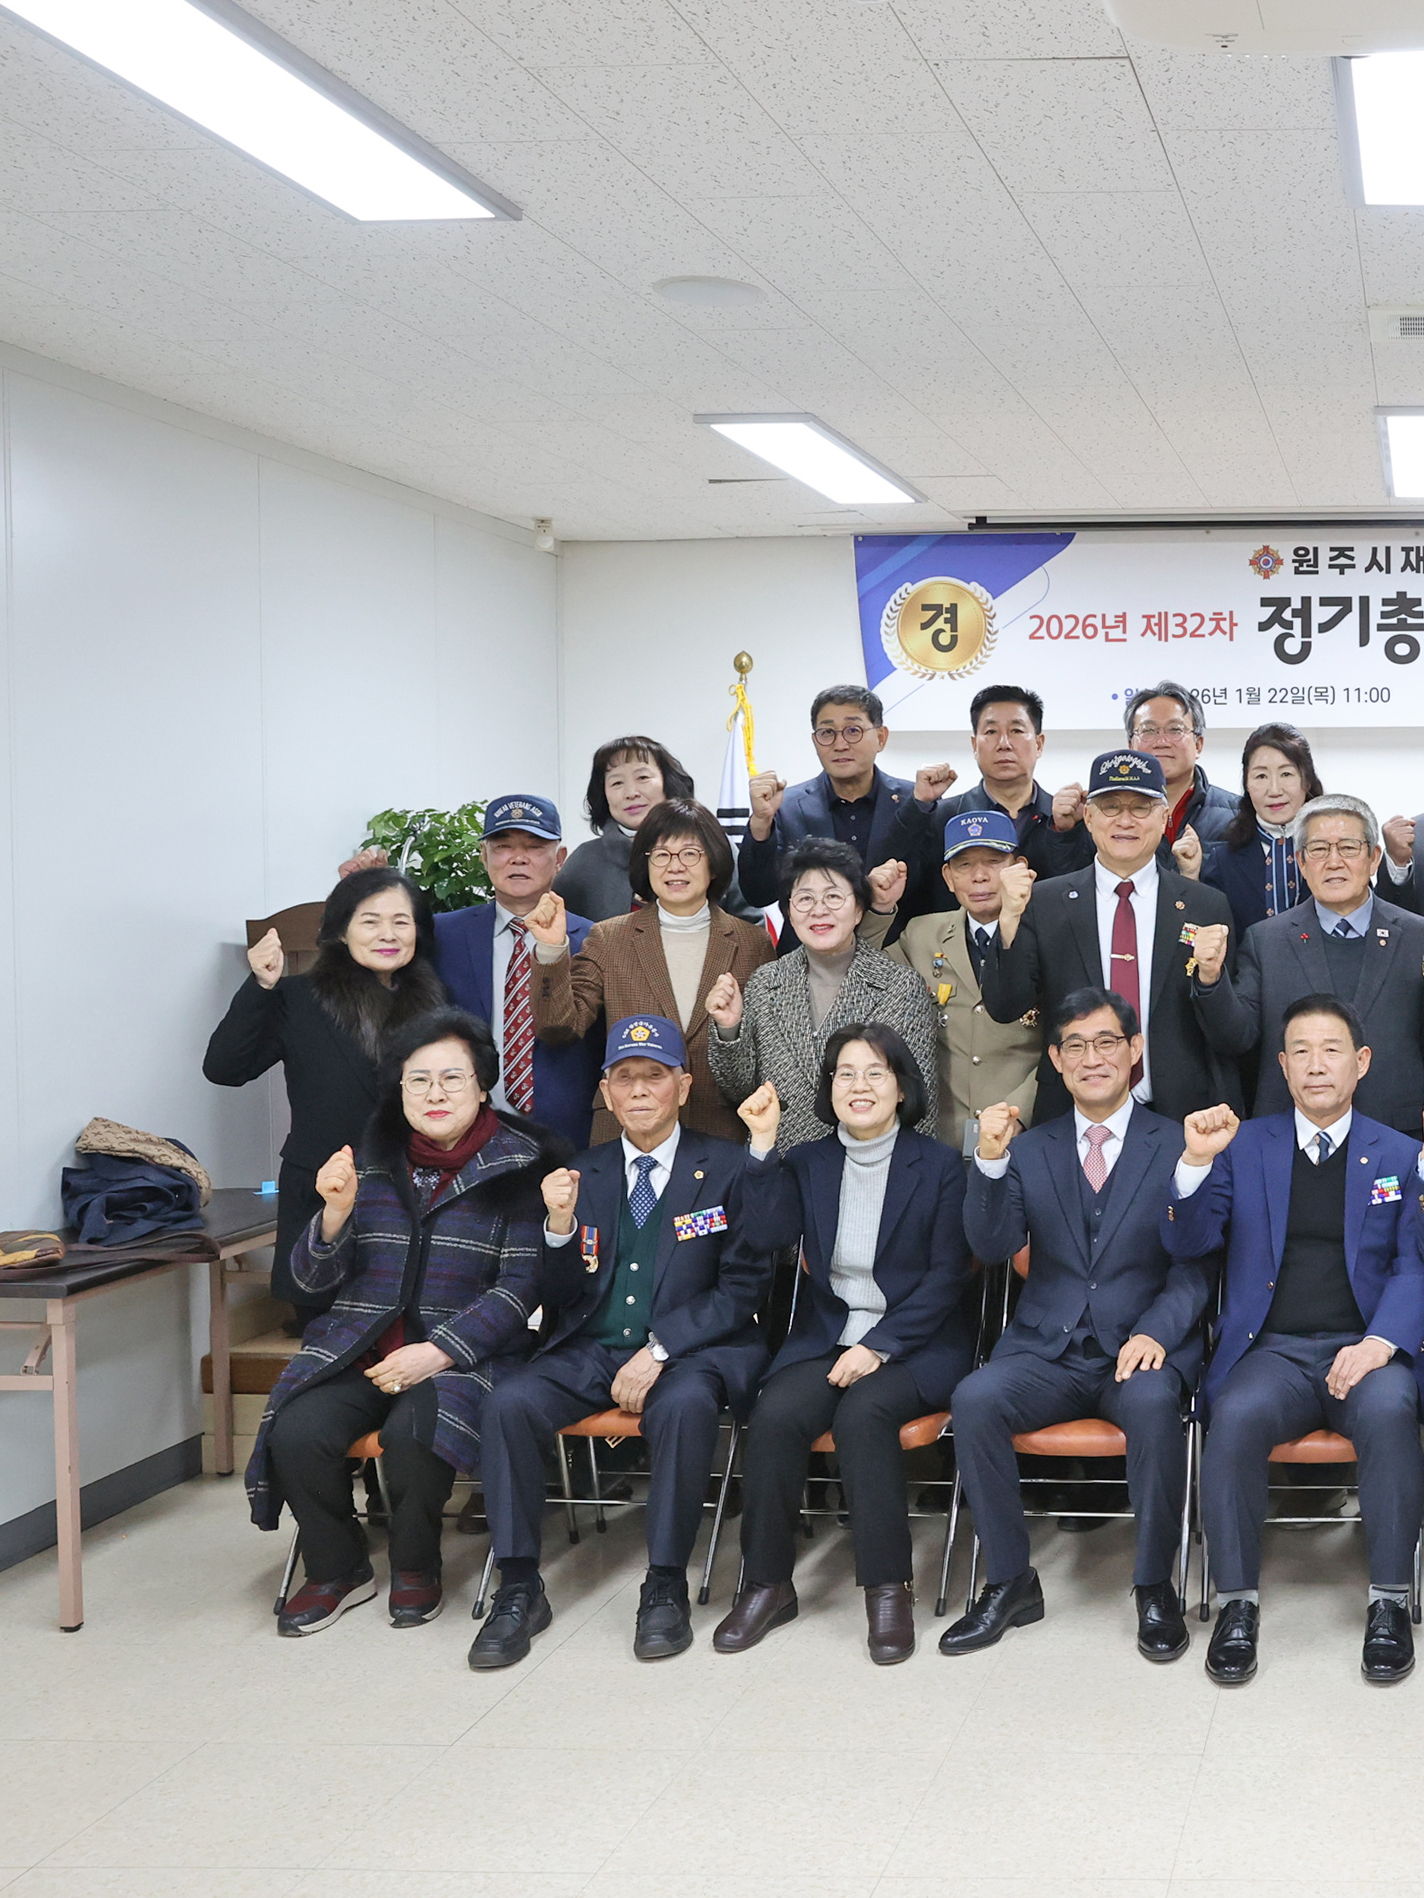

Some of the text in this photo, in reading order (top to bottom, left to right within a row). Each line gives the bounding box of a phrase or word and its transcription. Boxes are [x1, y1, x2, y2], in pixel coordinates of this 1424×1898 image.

[920, 602, 959, 653] 경
[1028, 610, 1239, 643] 2026년 제32차
[1235, 686, 1262, 705] 1월
[1267, 686, 1337, 705] 22일(목)
[1342, 686, 1391, 704] 11:00
